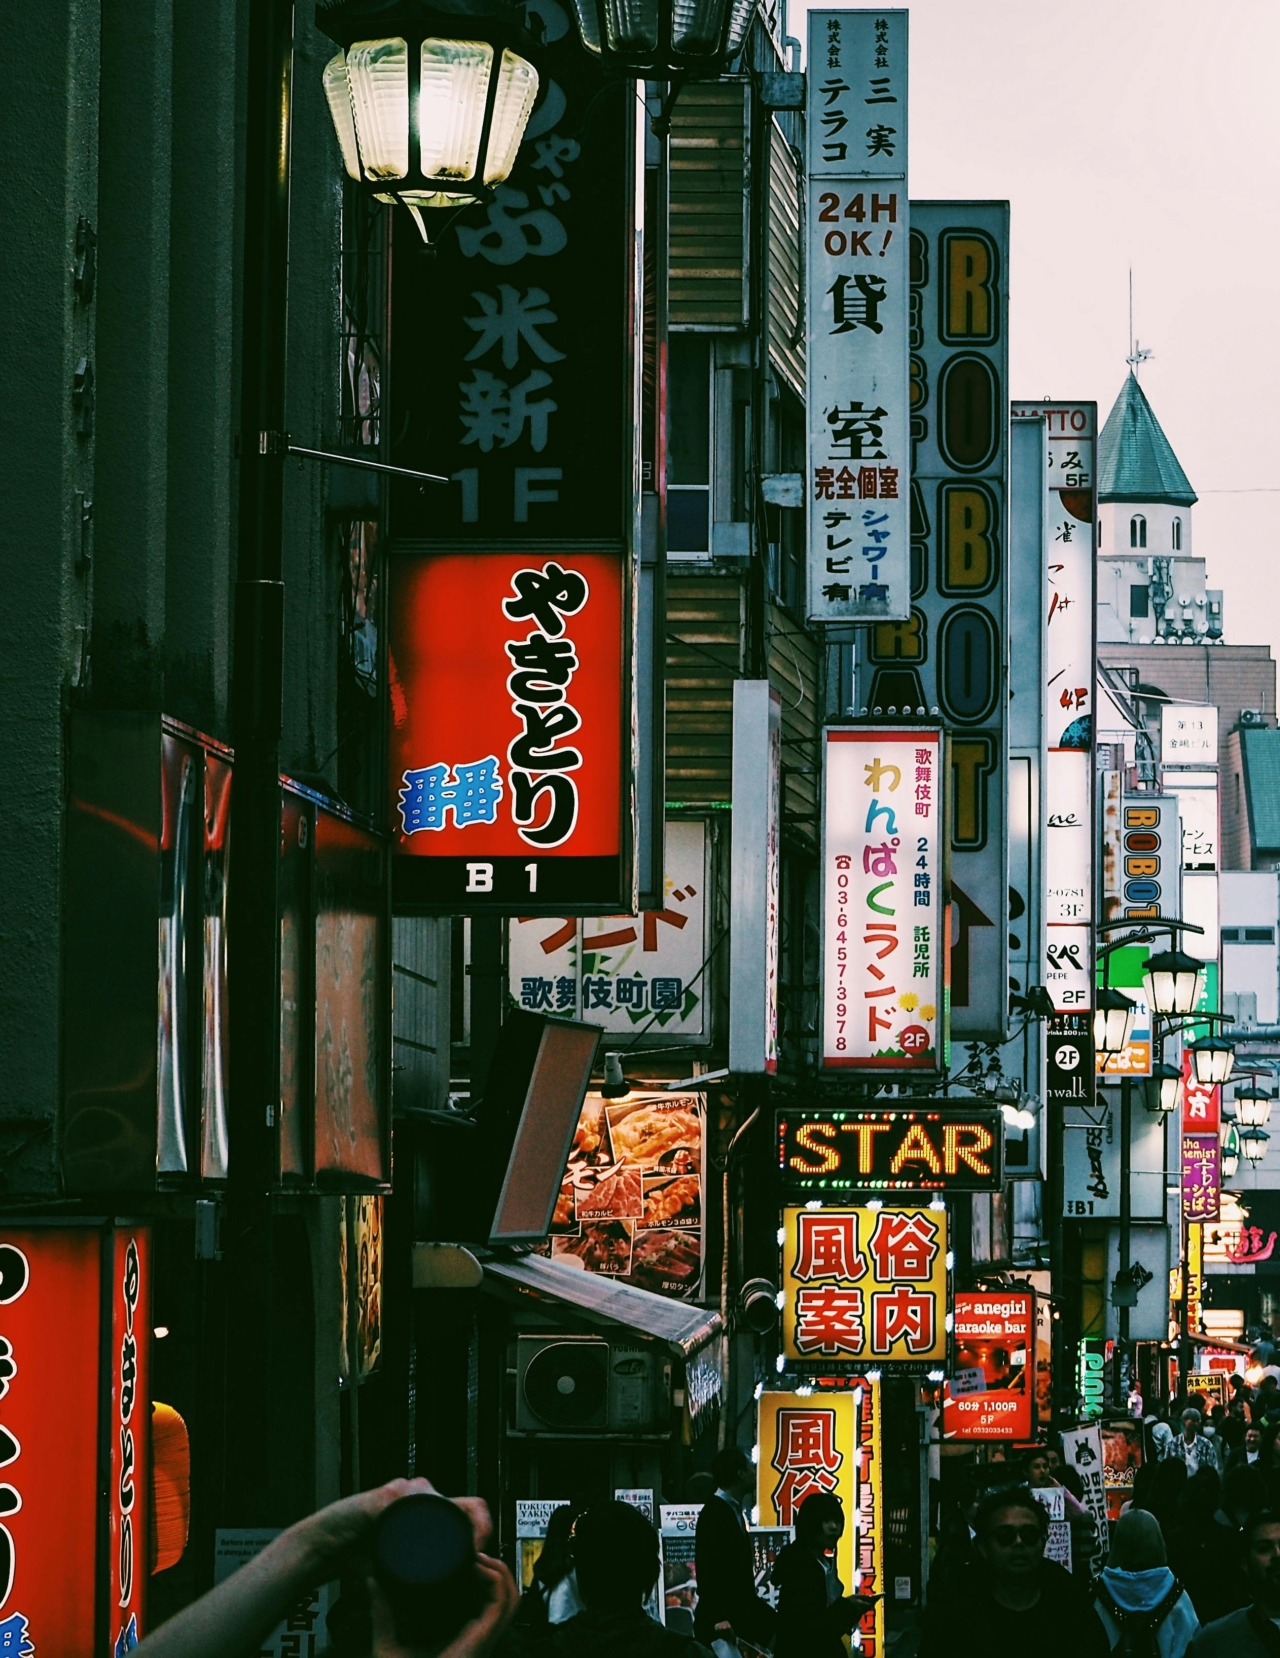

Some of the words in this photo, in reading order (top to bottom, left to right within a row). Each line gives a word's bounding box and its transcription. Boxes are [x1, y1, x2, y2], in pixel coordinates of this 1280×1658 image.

[827, 19, 842, 69] 株式会社
[874, 19, 889, 69] 株式会社
[818, 78, 850, 162] テラコ
[864, 77, 899, 158] 三実
[818, 193, 897, 224] 24H
[824, 230, 894, 258] OK!
[458, 284, 567, 453] 米新
[814, 466, 899, 500] 完全個室
[1065, 473, 1090, 487] 5F
[937, 227, 1001, 851] ROBOT
[502, 561, 589, 849] やきとり
[914, 748, 932, 818] 歌舞伎町
[913, 837, 931, 907] 24時間
[1124, 806, 1162, 919] ROBOT
[863, 757, 902, 1042] わんぱくランド
[1060, 904, 1084, 917] 3F
[835, 874, 849, 1051] 03-6457-3978
[913, 925, 931, 978] 託児所
[521, 976, 685, 1011] 歌舞伎町園
[1062, 990, 1086, 1004] 2F
[904, 1032, 926, 1047] 2F
[1058, 1050, 1077, 1065] 2F
[1056, 1076, 1088, 1098] walk
[789, 1123, 994, 1175] STAR
[1075, 1200, 1094, 1216] B1
[794, 1213, 937, 1282] 風俗
[796, 1284, 936, 1354] 案内
[973, 1299, 1027, 1318] anegirl
[1004, 1320, 1027, 1334] bar
[958, 1401, 980, 1412] 60分
[983, 1401, 1017, 1413] 1,100円
[980, 1414, 995, 1425] 5F
